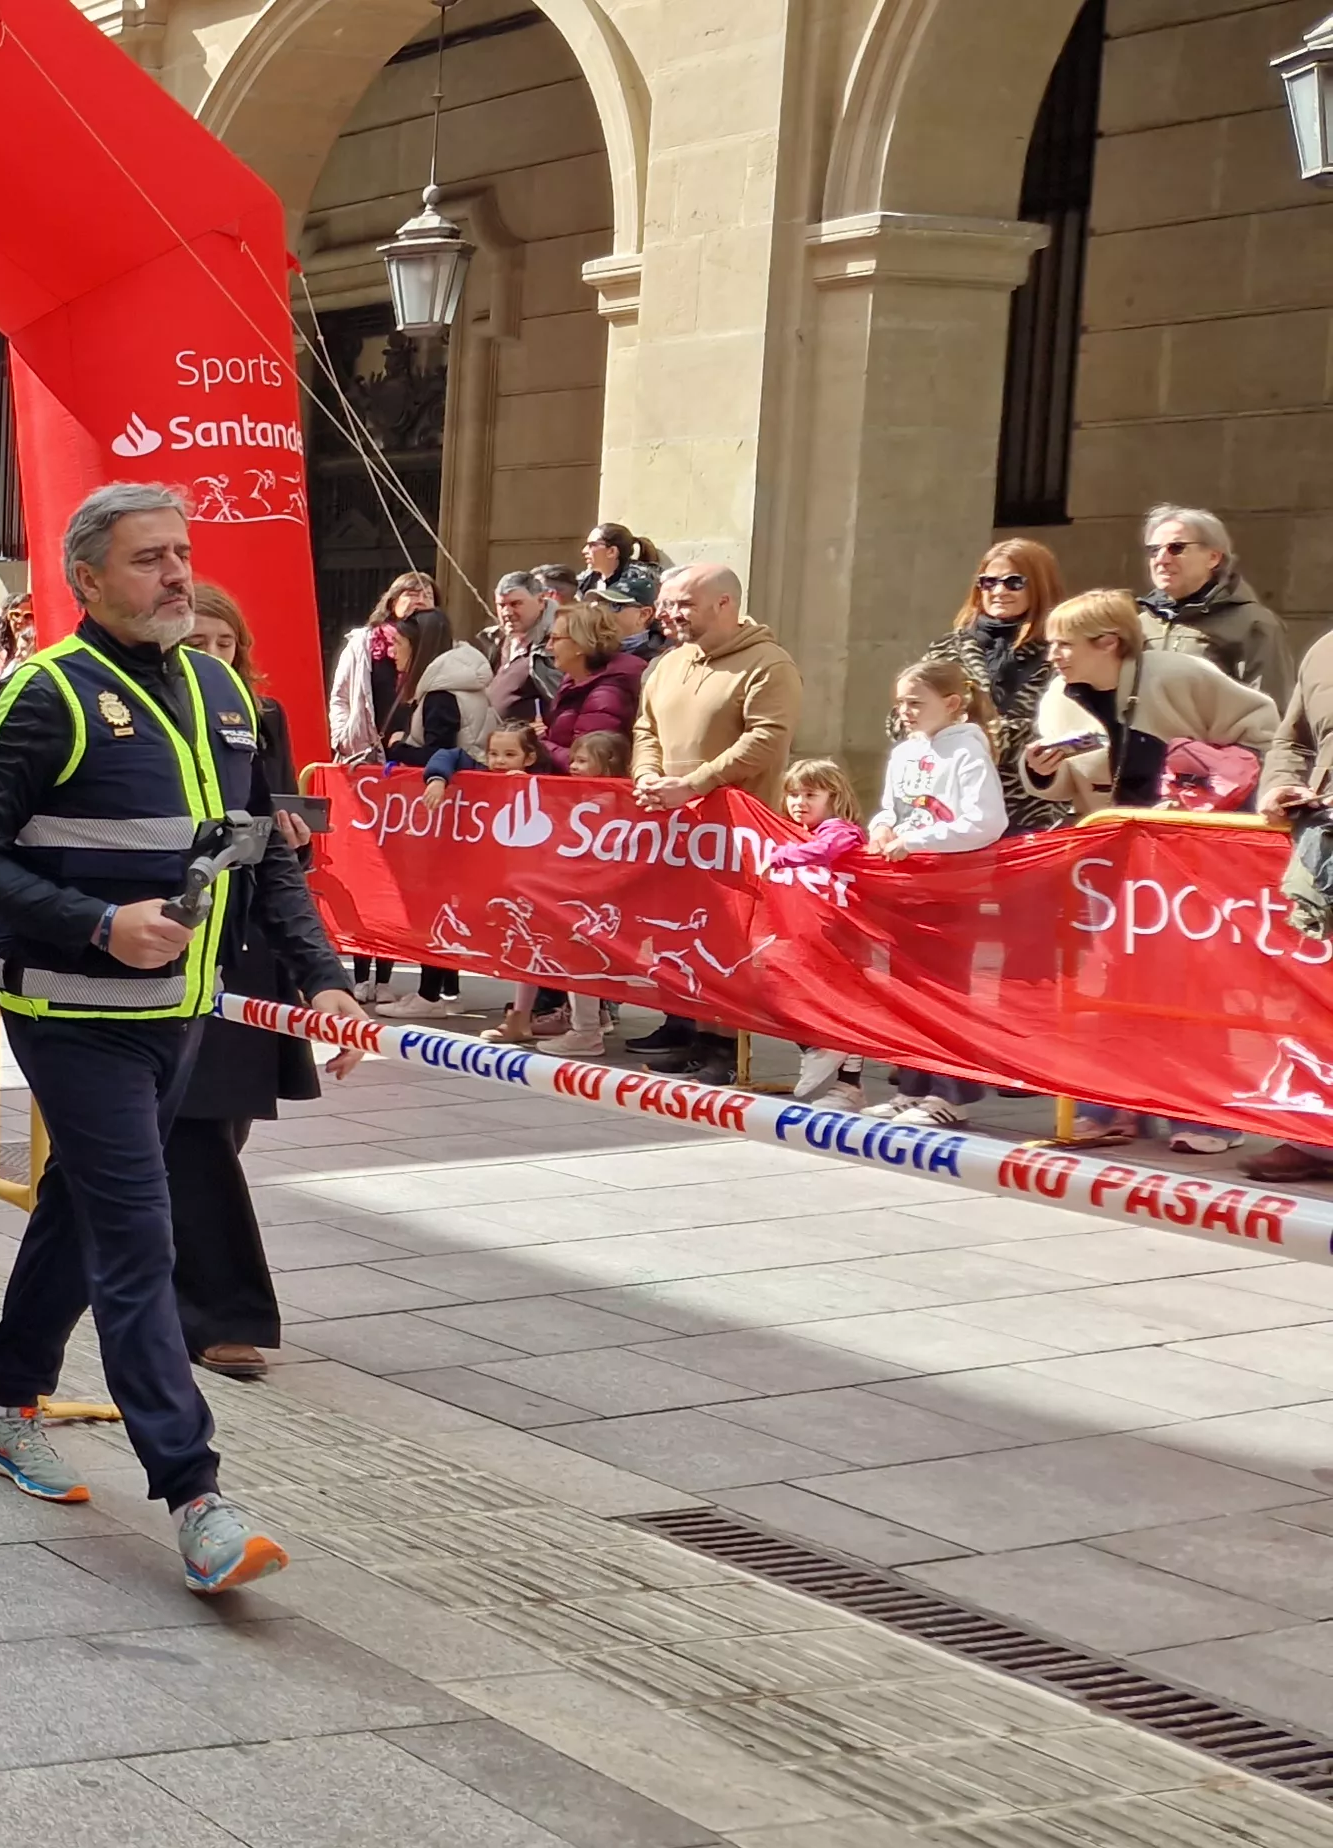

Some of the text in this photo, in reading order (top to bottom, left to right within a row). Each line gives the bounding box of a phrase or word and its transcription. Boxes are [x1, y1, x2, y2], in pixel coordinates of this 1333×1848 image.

[175, 350, 282, 393] Sports
[169, 413, 304, 455] Santande
[351, 776, 490, 847] Sports
[242, 998, 278, 1030] NO
[287, 1005, 388, 1054] PASAR
[400, 1031, 533, 1086] POLICIA
[553, 1061, 611, 1101] NO
[615, 1074, 757, 1132] PASAR
[775, 1104, 968, 1178] POLICIA
[998, 1147, 1081, 1200] NO
[1090, 1165, 1298, 1244] PASAR
